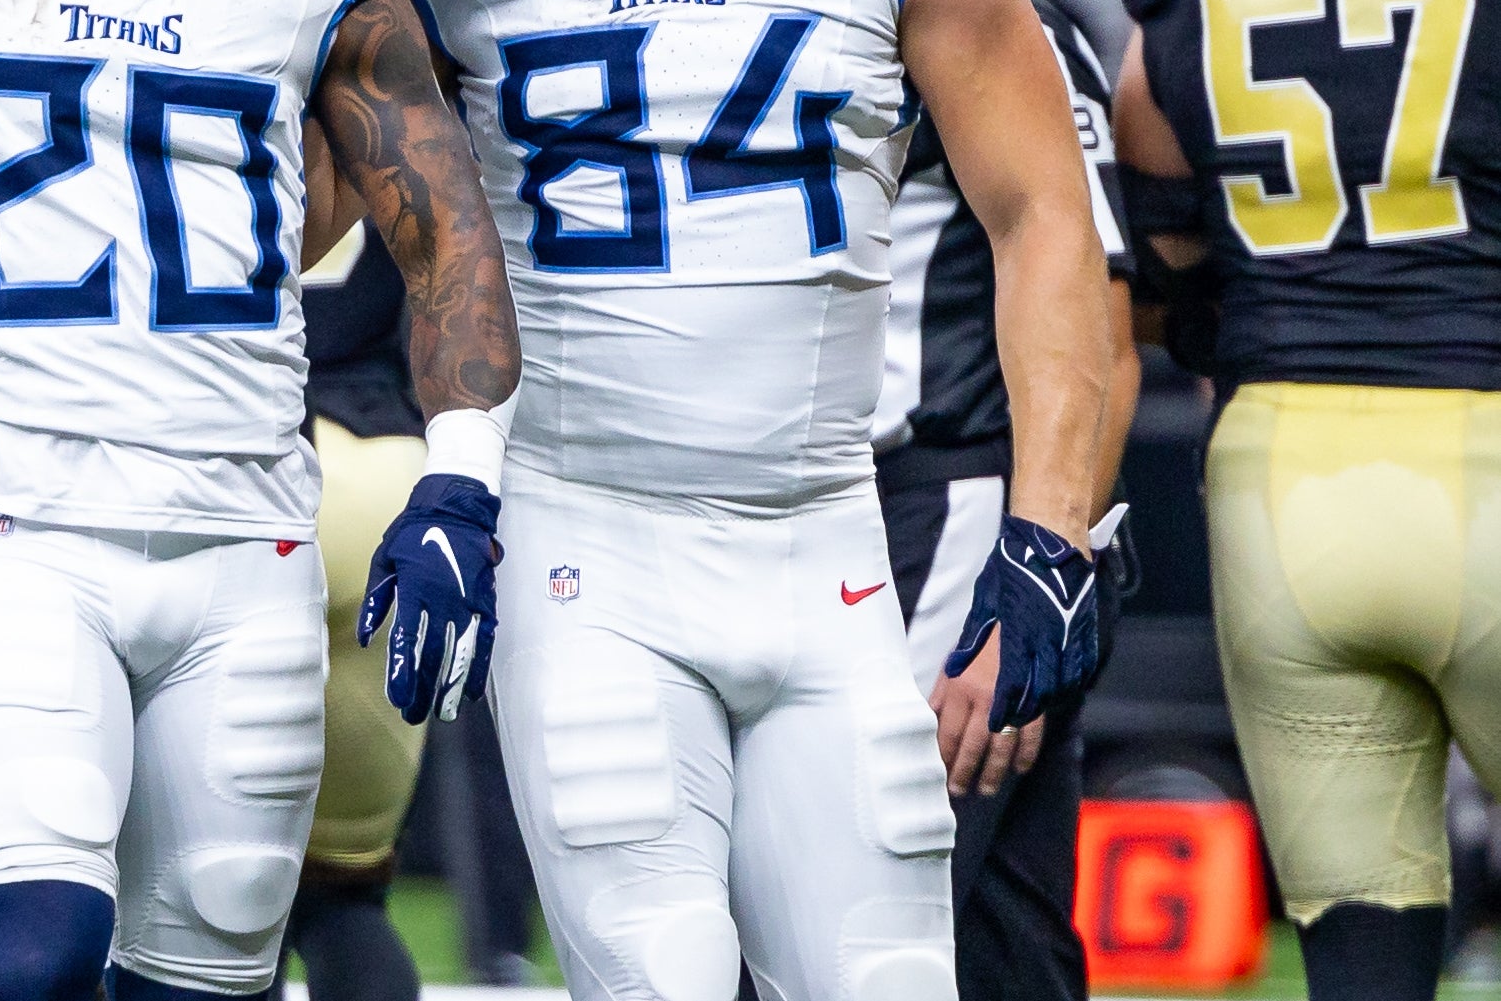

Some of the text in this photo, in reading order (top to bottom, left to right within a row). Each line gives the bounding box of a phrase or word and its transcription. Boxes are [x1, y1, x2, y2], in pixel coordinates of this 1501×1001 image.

[59, 3, 183, 55] TITANS
[498, 12, 854, 273] 84
[552, 580, 576, 596] NFL
[1100, 834, 1191, 954] G
